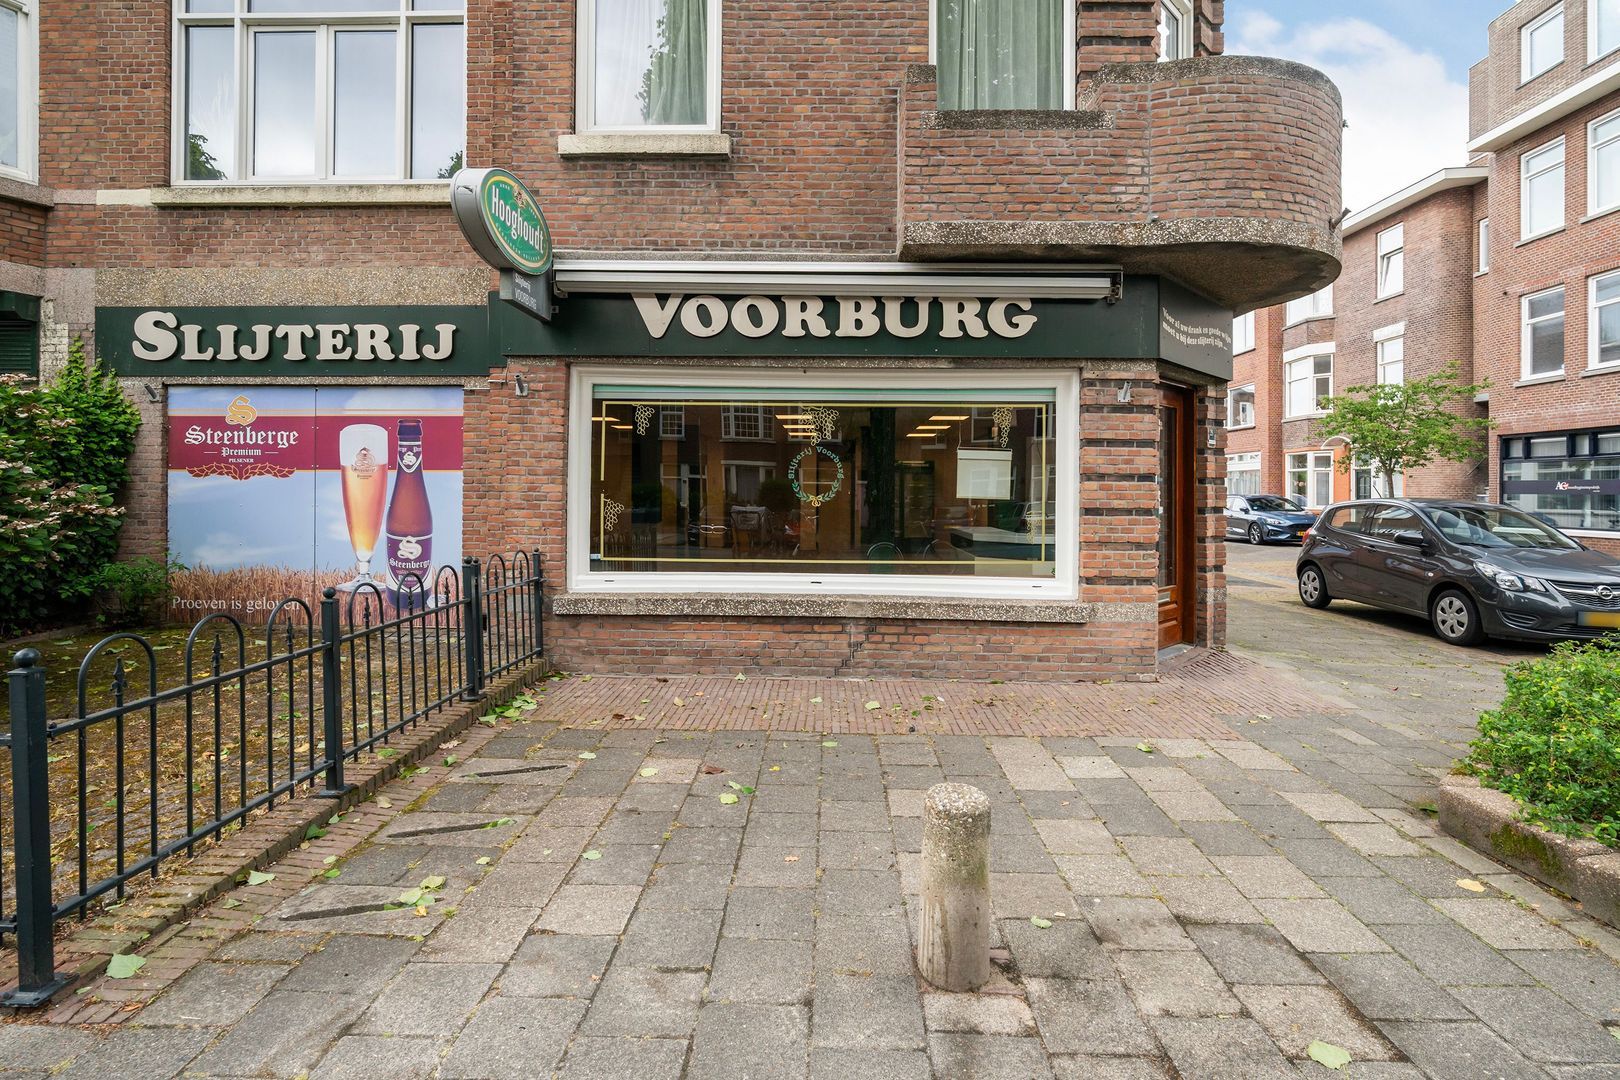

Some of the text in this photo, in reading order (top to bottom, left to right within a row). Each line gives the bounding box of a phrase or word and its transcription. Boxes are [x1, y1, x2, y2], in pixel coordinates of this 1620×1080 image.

[491, 184, 544, 254] Hooghoudt
[631, 293, 1038, 339] VOORBURG
[132, 310, 457, 361] SLIJTERIJ
[184, 425, 299, 449] Steenberge
[221, 447, 262, 457] Premium
[788, 445, 845, 479] Slijterij Voorburg
[172, 596, 226, 609] Proeven
[231, 596, 242, 609] is
